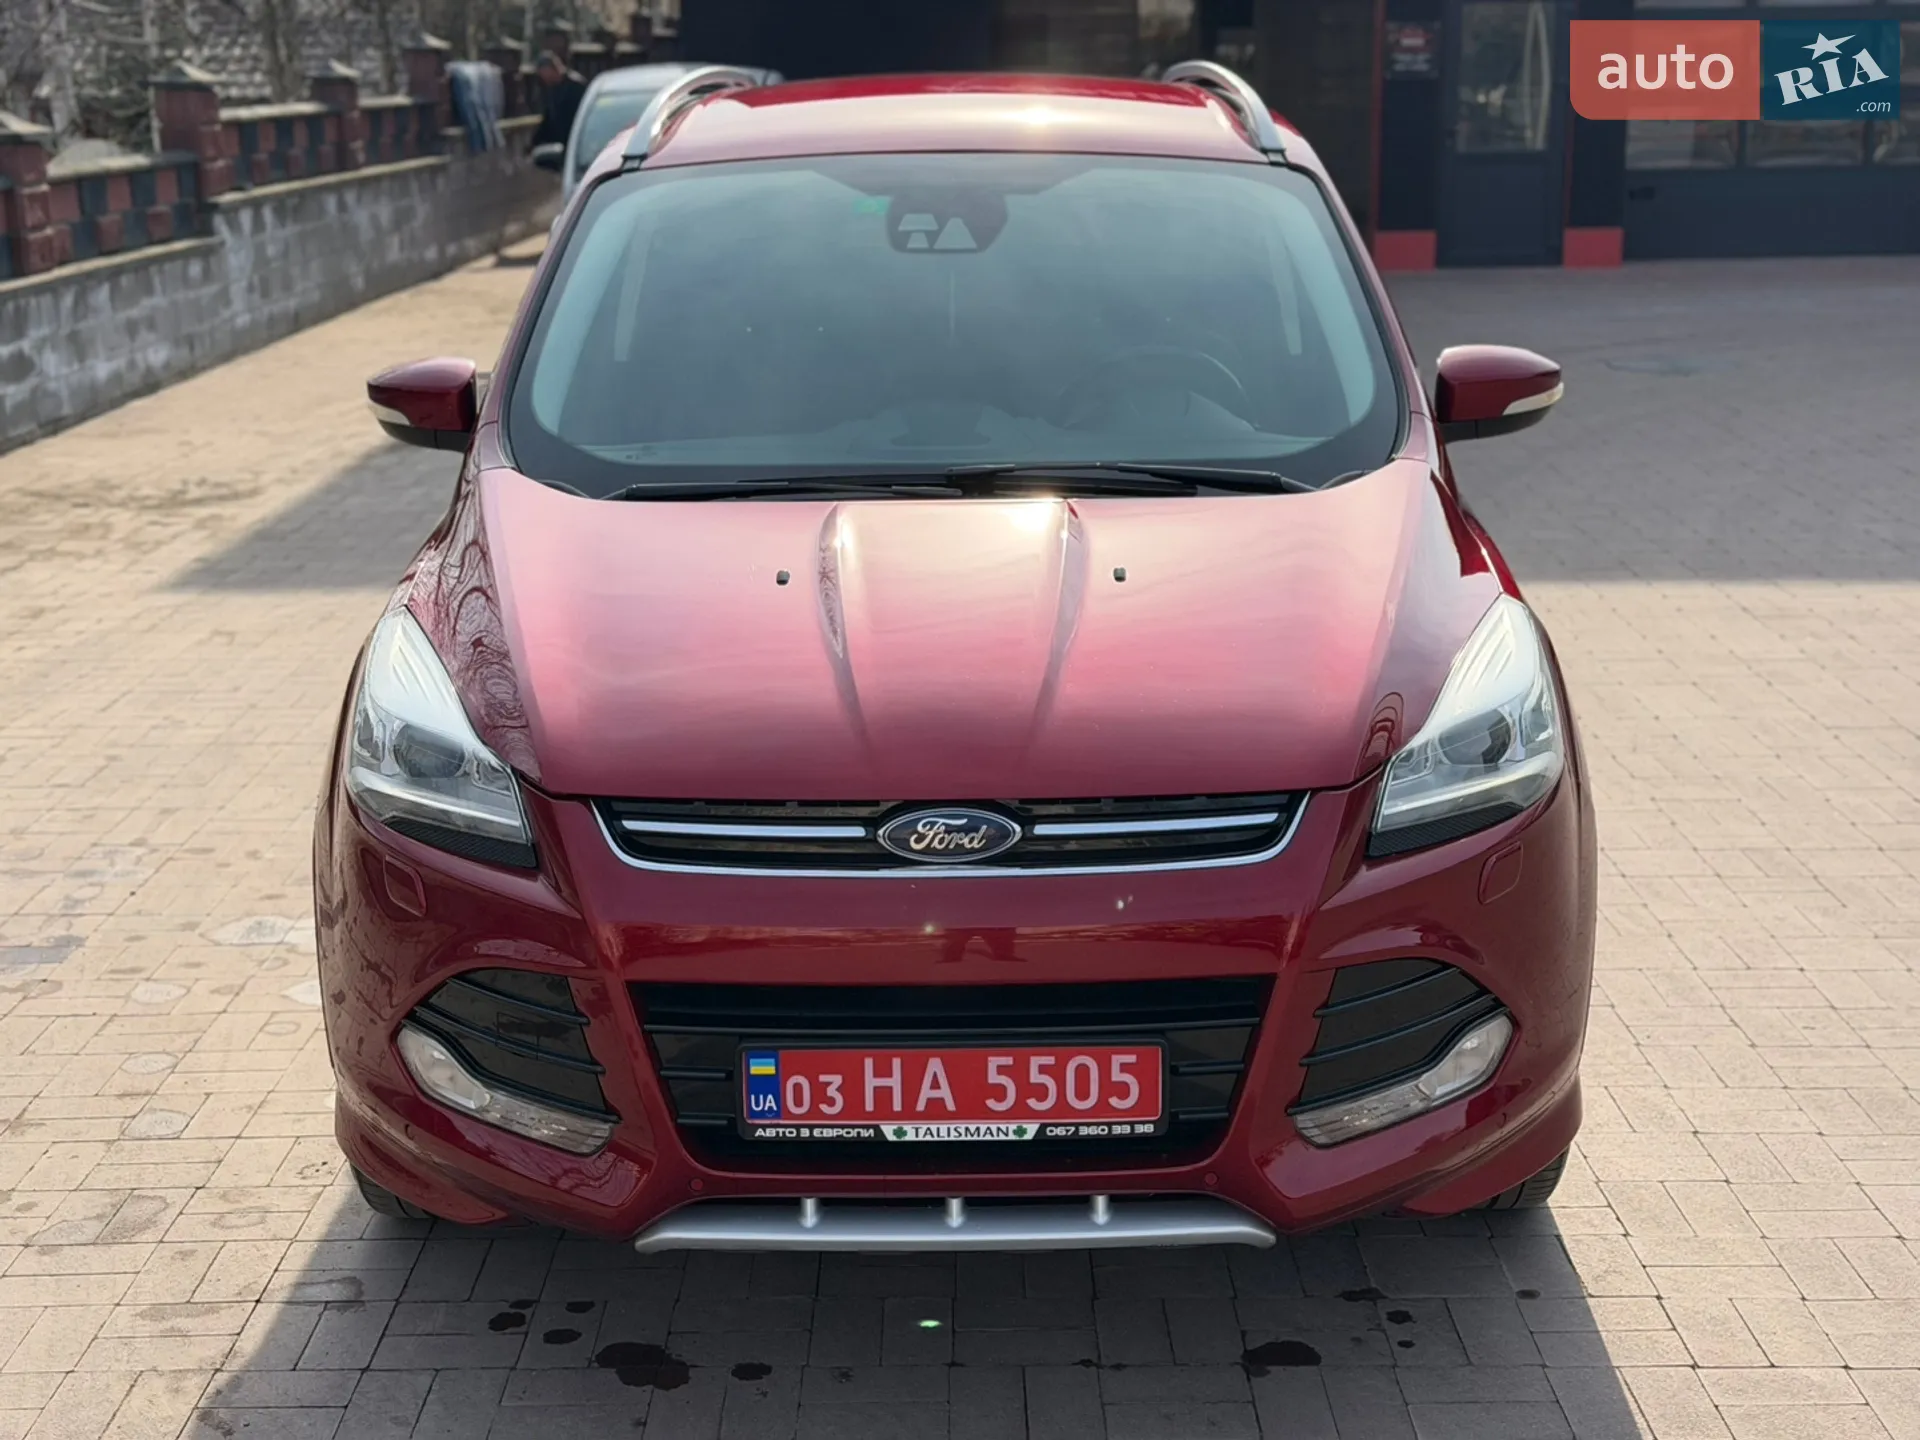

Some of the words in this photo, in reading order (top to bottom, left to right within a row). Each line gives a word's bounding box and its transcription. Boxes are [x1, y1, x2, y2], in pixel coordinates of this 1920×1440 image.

[909, 817, 988, 851] Ford
[785, 1074, 845, 1116] 03
[985, 1053, 1140, 1112] 5505
[750, 1093, 778, 1112] UA
[754, 1127, 798, 1138] АВТО
[813, 1127, 875, 1138] ЄВРОПИ
[911, 1126, 1010, 1139] TALISMAN
[1045, 1126, 1076, 1137] 067
